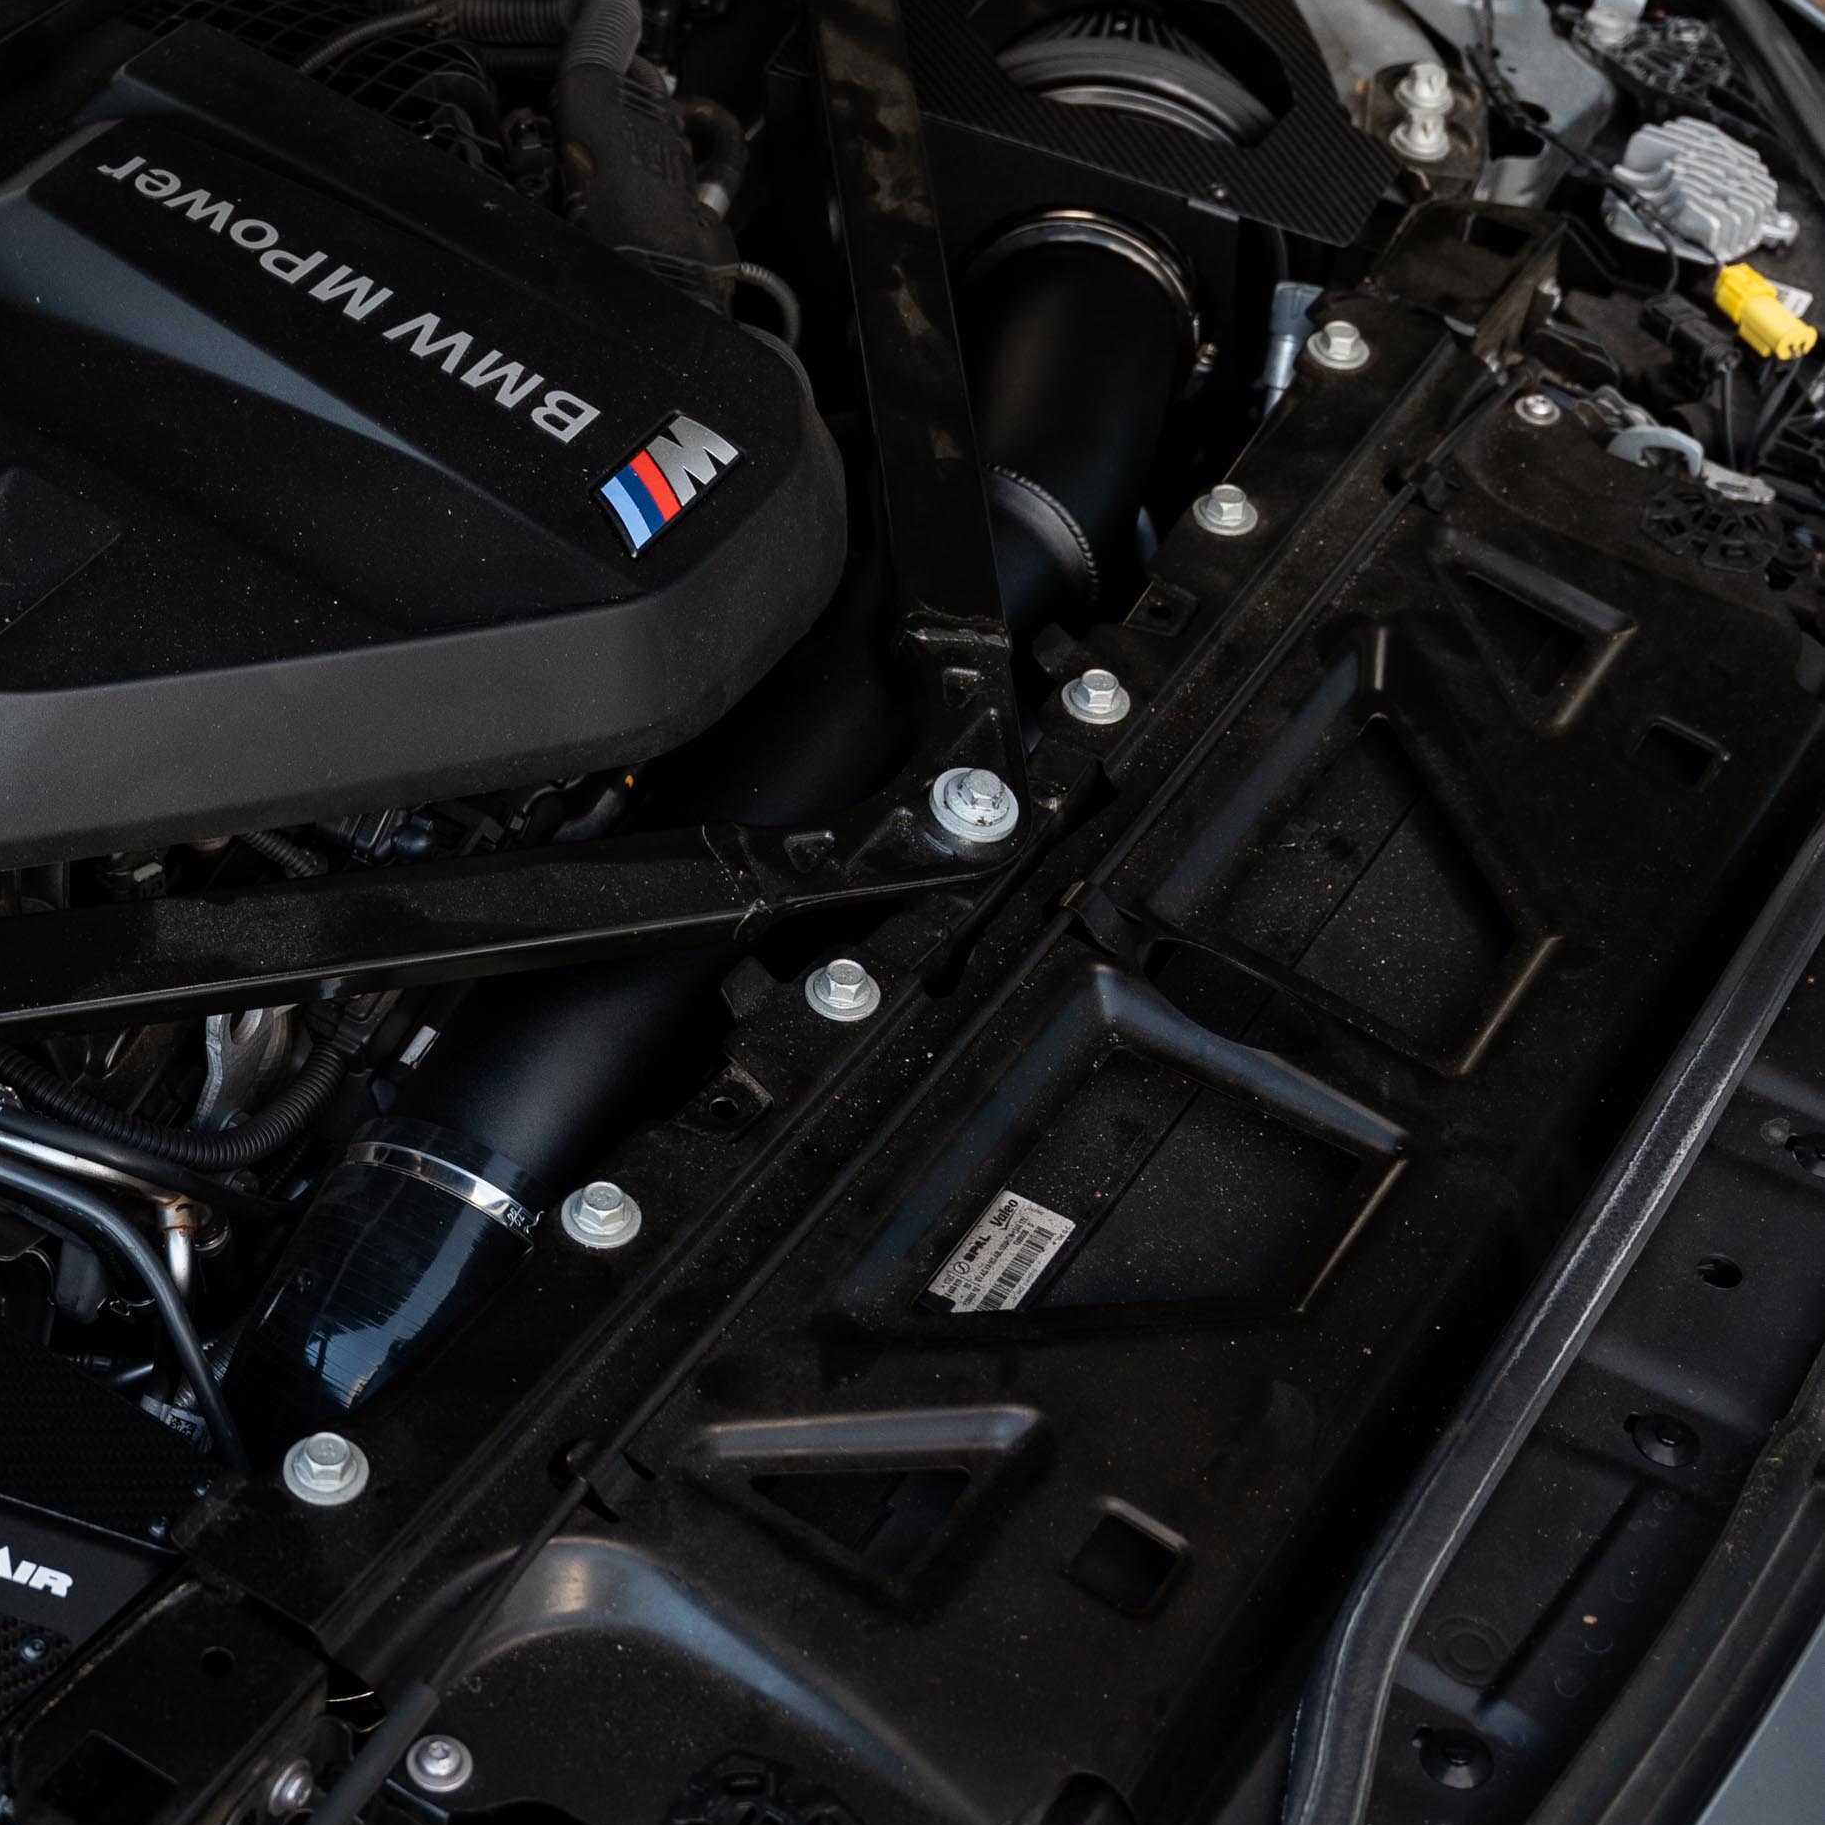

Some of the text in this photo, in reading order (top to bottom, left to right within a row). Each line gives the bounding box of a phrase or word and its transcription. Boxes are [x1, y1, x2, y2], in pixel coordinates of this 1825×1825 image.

[384, 311, 601, 444] BMW
[649, 415, 738, 506] M
[990, 1199, 1018, 1229] Valeo
